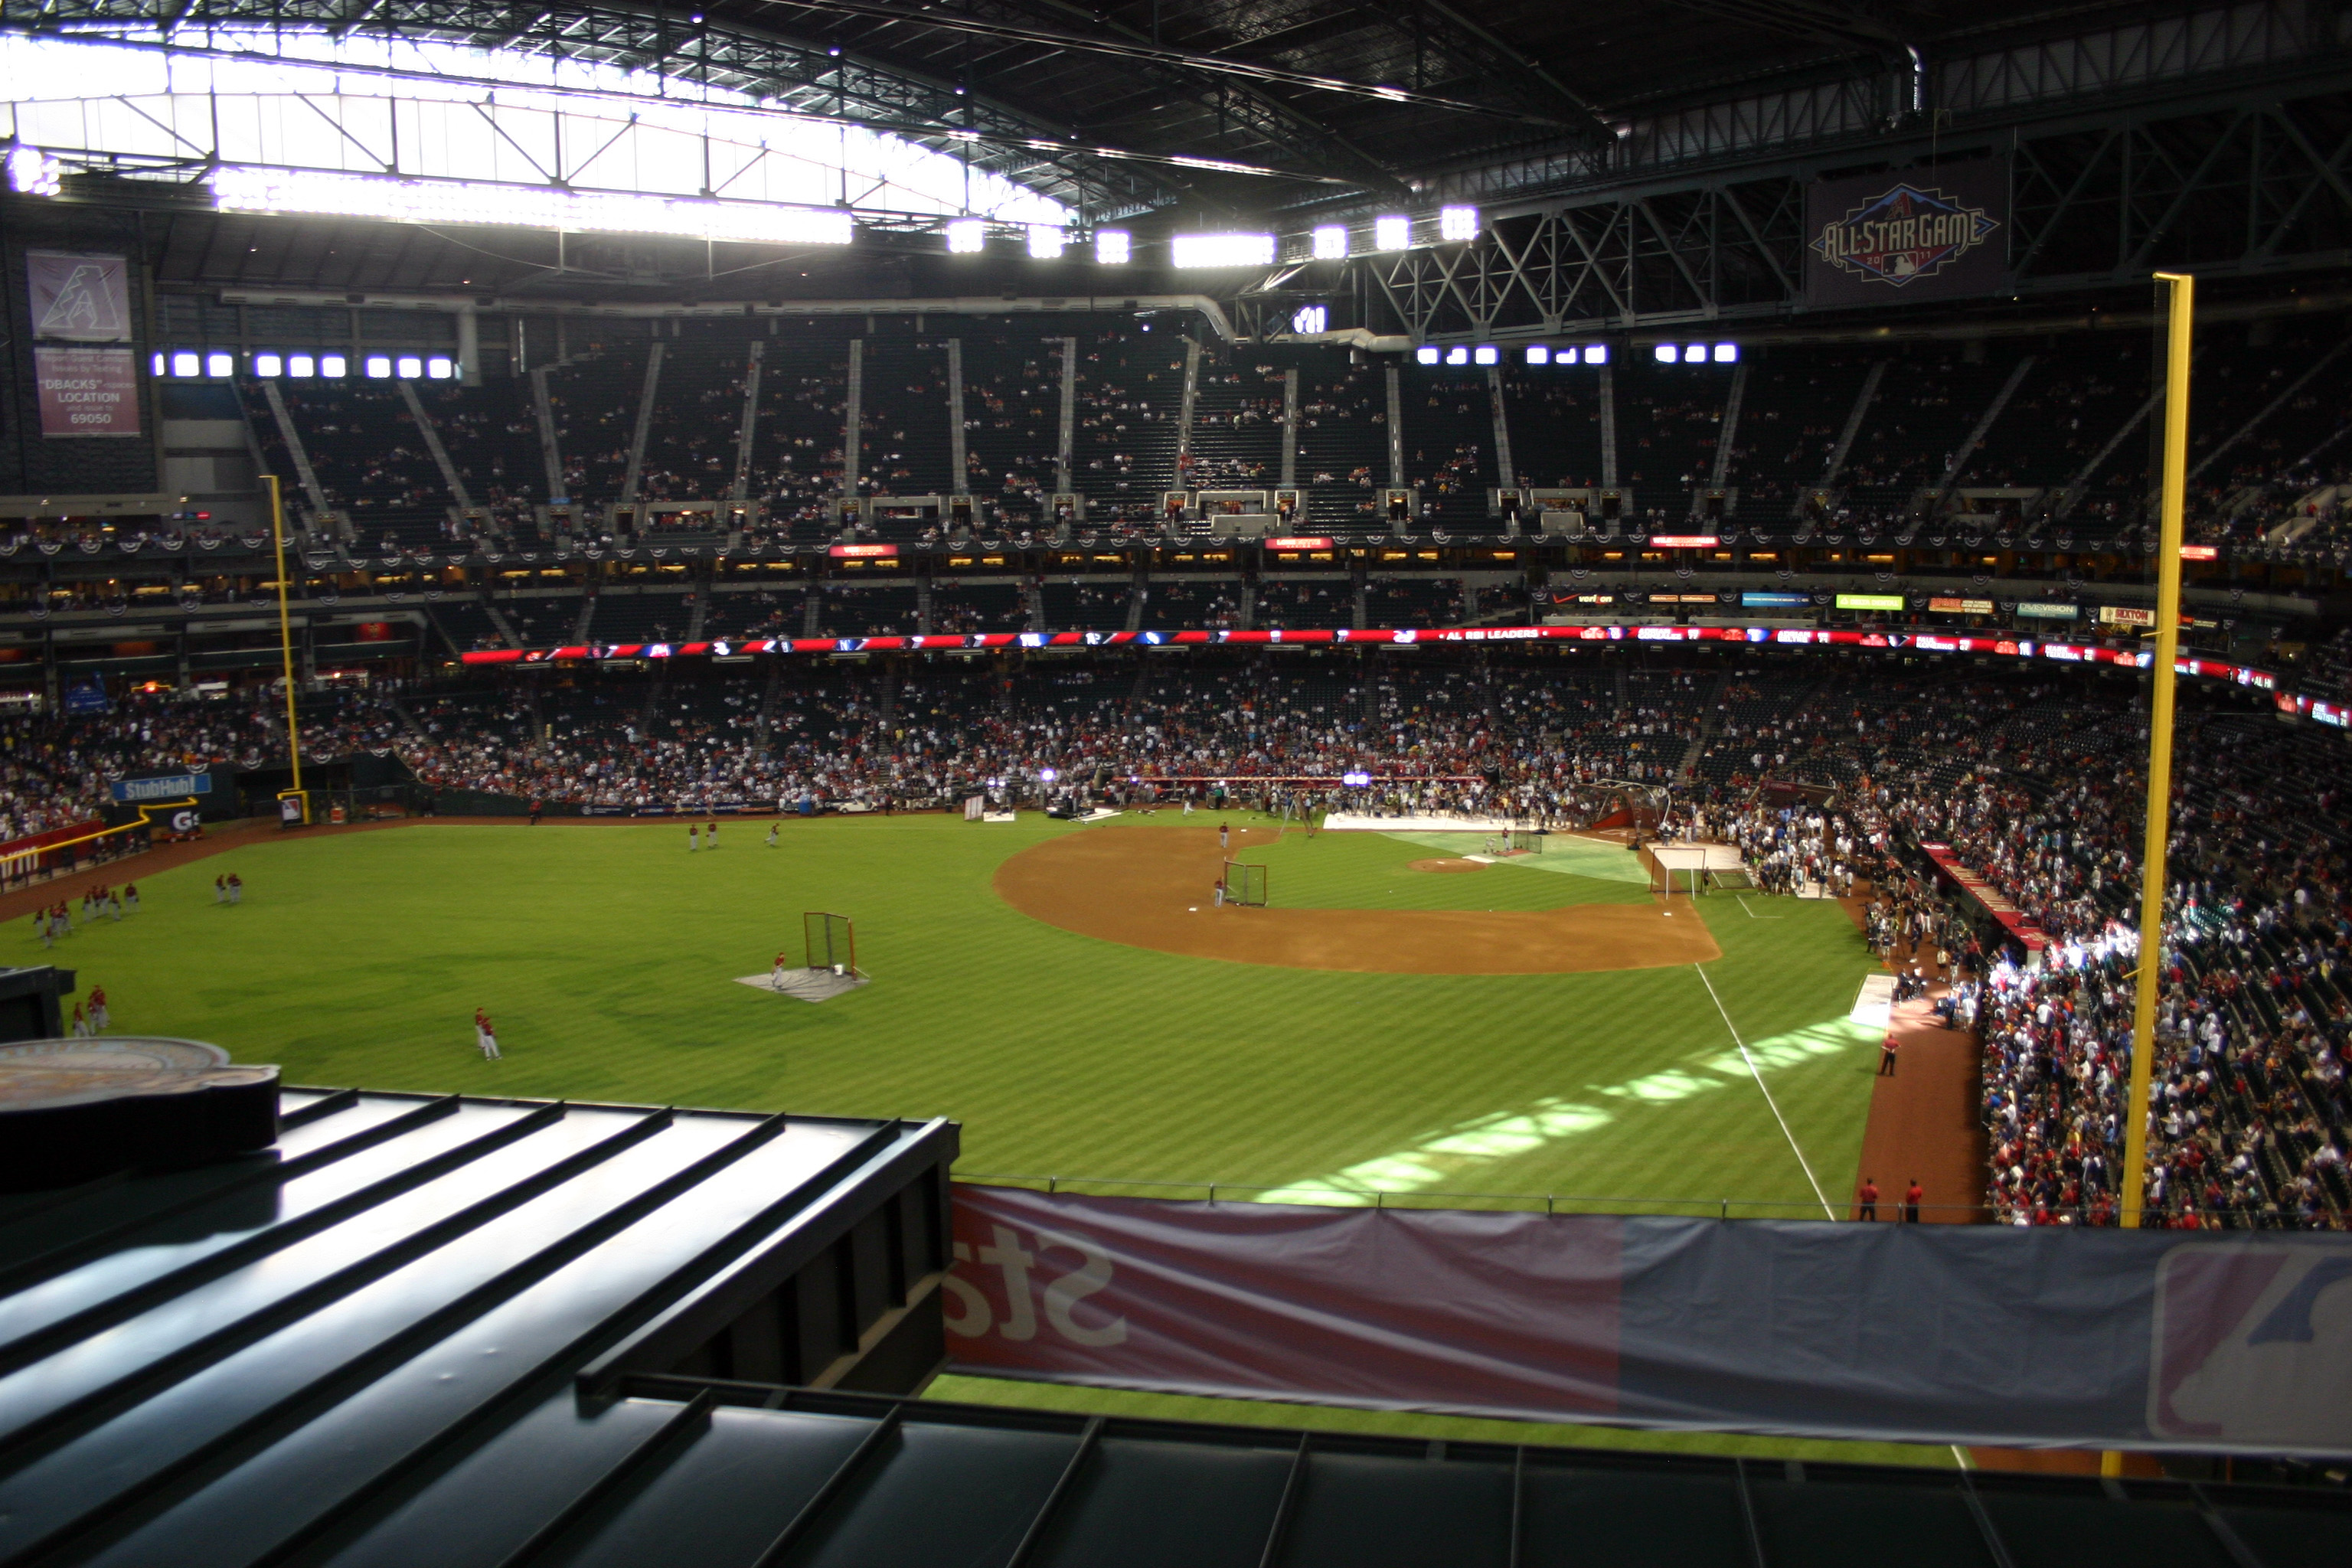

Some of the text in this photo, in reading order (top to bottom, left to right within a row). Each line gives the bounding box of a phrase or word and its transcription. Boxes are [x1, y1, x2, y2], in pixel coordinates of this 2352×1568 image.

[1919, 209, 1984, 256] GAME
[58, 393, 120, 403] LOCATION
[70, 413, 112, 423] 69050
[1578, 594, 1612, 604] verizon
[1446, 629, 1539, 640] AL RBI LEADERS
[2253, 676, 2262, 687] AL
[125, 776, 196, 799] StubHub!
